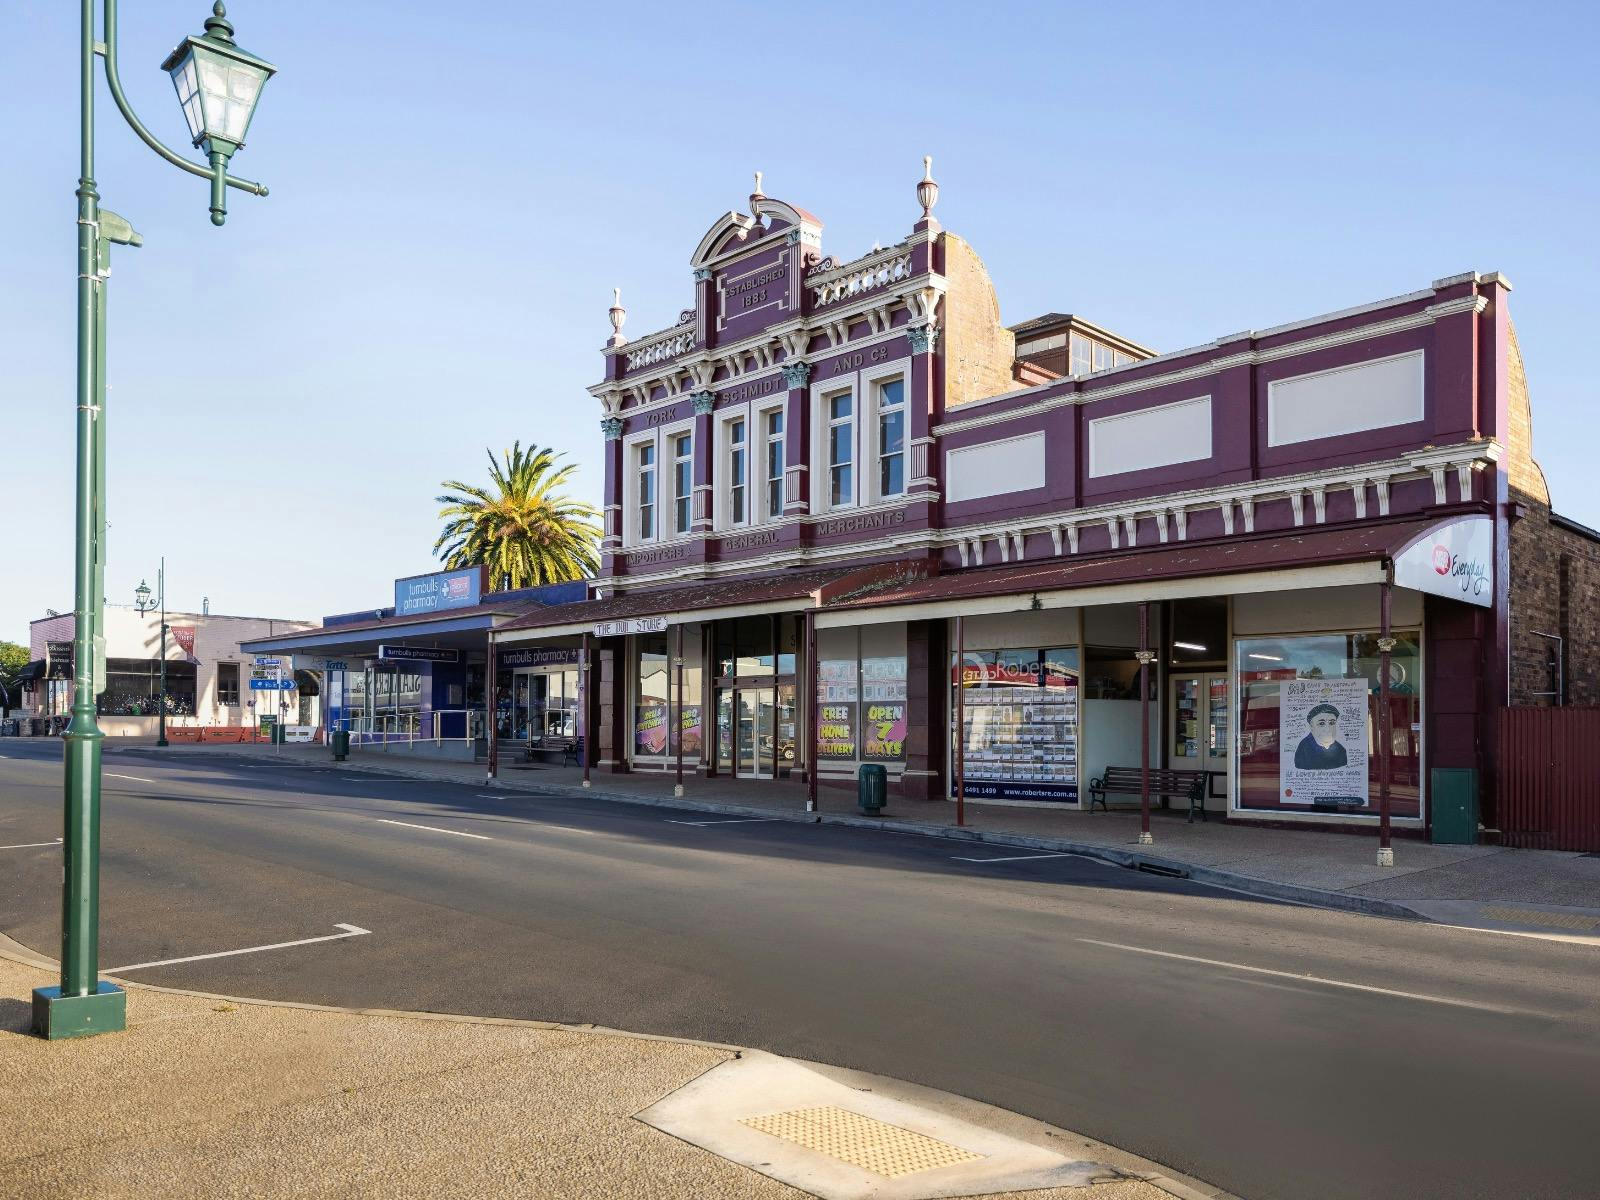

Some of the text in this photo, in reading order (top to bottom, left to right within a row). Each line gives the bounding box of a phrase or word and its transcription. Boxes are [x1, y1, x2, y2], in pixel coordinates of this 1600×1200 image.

[725, 269, 784, 298] ESTABLISHED
[743, 290, 767, 308] 1883
[833, 354, 863, 374] AND
[722, 378, 783, 404] SCHMIDT
[645, 408, 676, 425] YORK
[817, 512, 905, 535] MERCHANTS
[724, 532, 779, 550] GENERAL
[626, 548, 684, 565] IMPORTERS
[1452, 554, 1489, 595] Everyday
[409, 578, 438, 596] turnbulls
[404, 595, 438, 614] pharmacy
[597, 624, 612, 635] THE
[503, 648, 569, 664] turnbulls pharmacy
[325, 660, 348, 670] Tatts
[996, 659, 1066, 678] Roberts
[821, 706, 849, 722] FREE
[868, 705, 904, 722] OPEN
[820, 724, 851, 740] HOME
[876, 722, 894, 741] 7
[817, 742, 855, 757] DELIVERY
[865, 740, 902, 757] DAYS
[981, 787, 997, 795] 1499
[1003, 788, 1077, 798] www.robertsre.com.au
